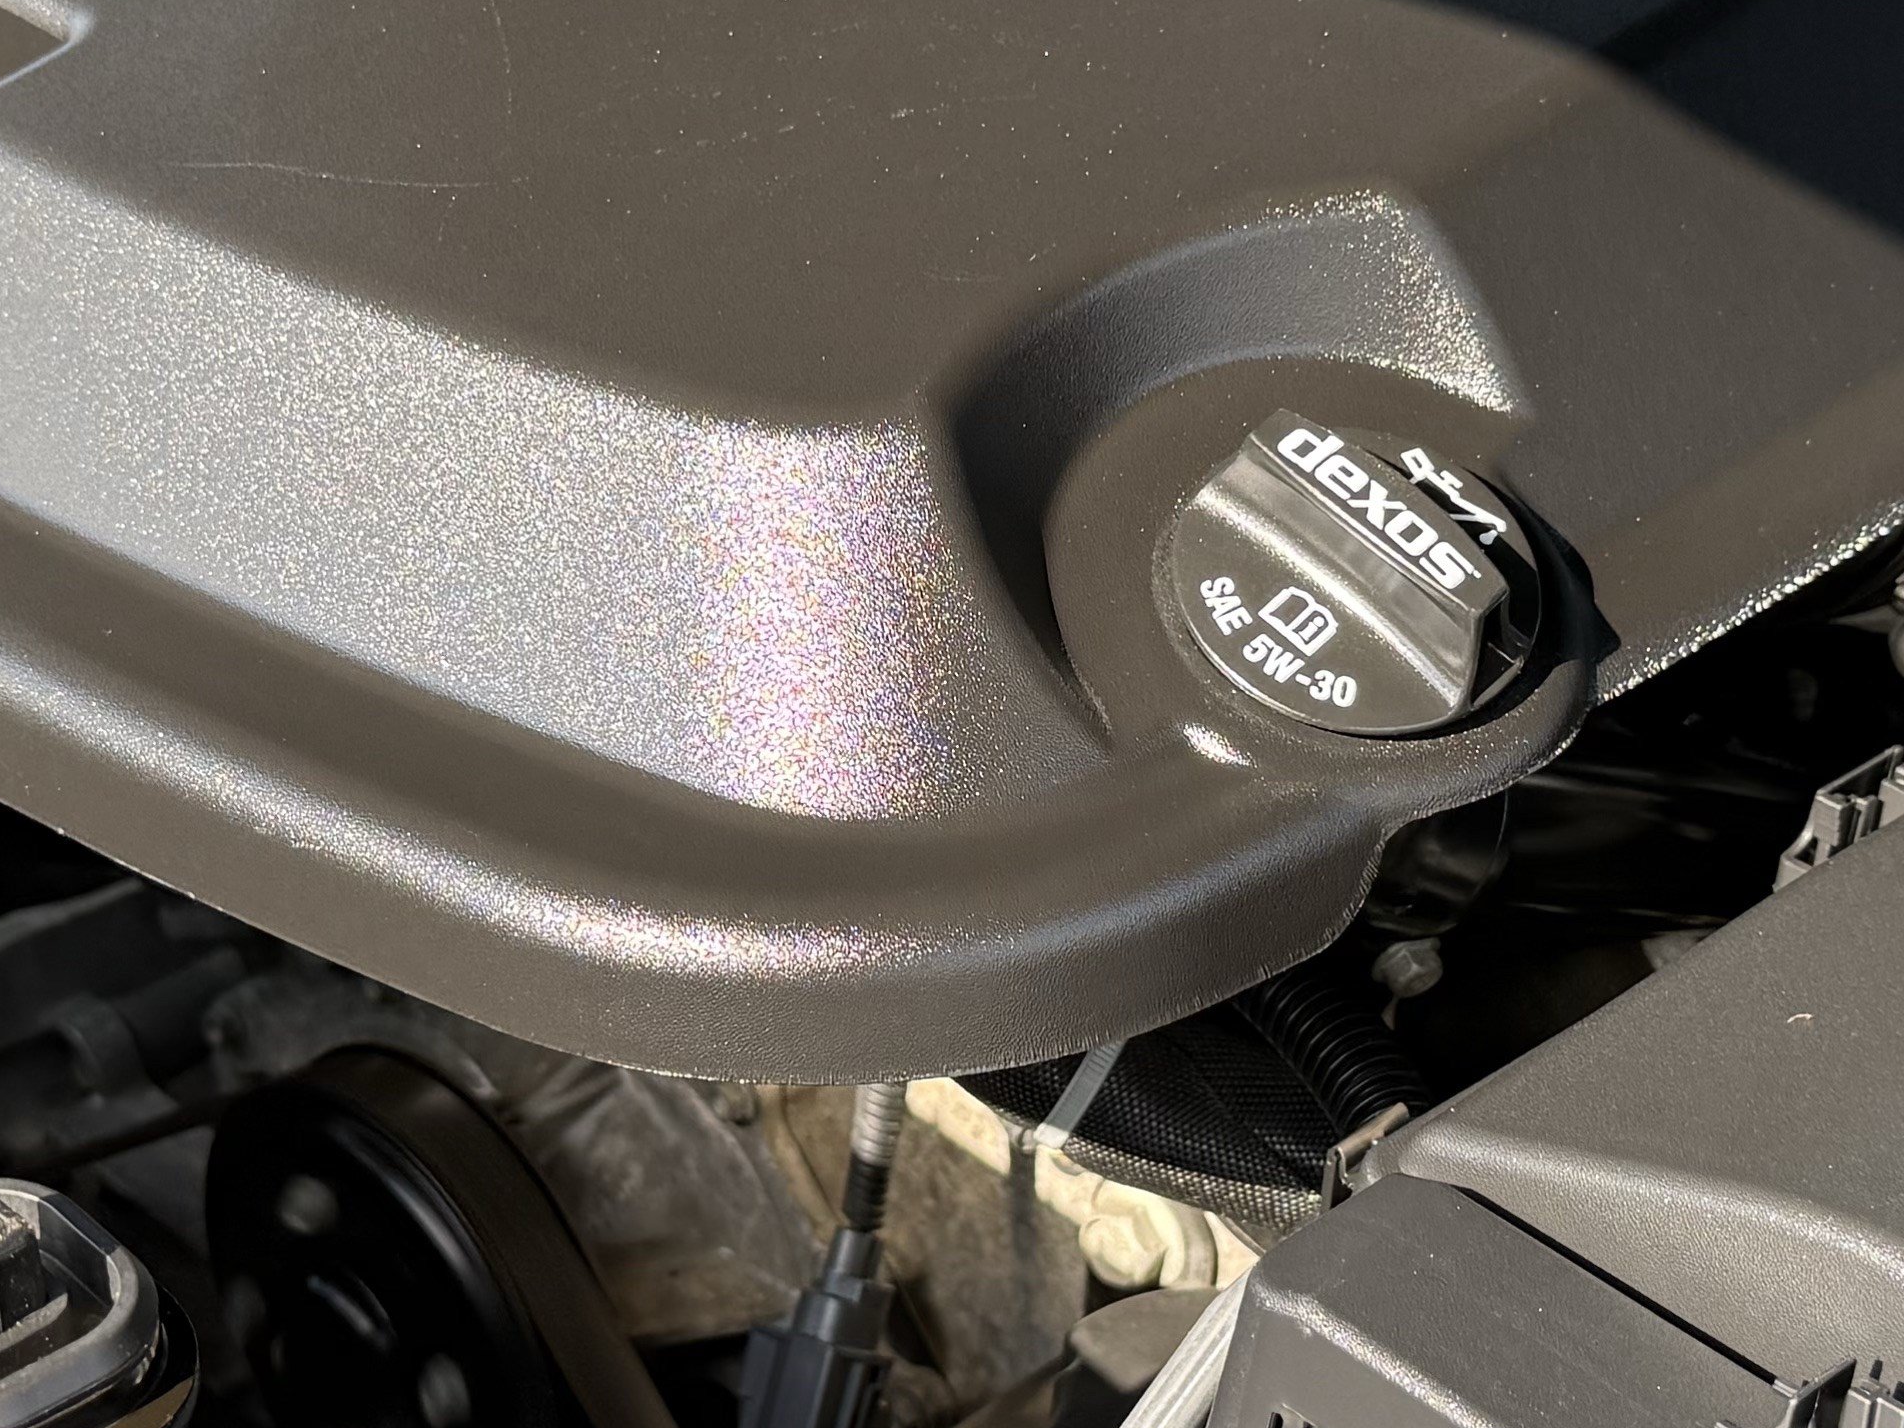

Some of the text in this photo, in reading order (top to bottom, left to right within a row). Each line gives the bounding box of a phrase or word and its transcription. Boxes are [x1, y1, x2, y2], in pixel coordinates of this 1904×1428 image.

[1277, 428, 1470, 590] dexos
[1200, 576, 1252, 635] SAE
[1243, 634, 1357, 707] 5W-30
